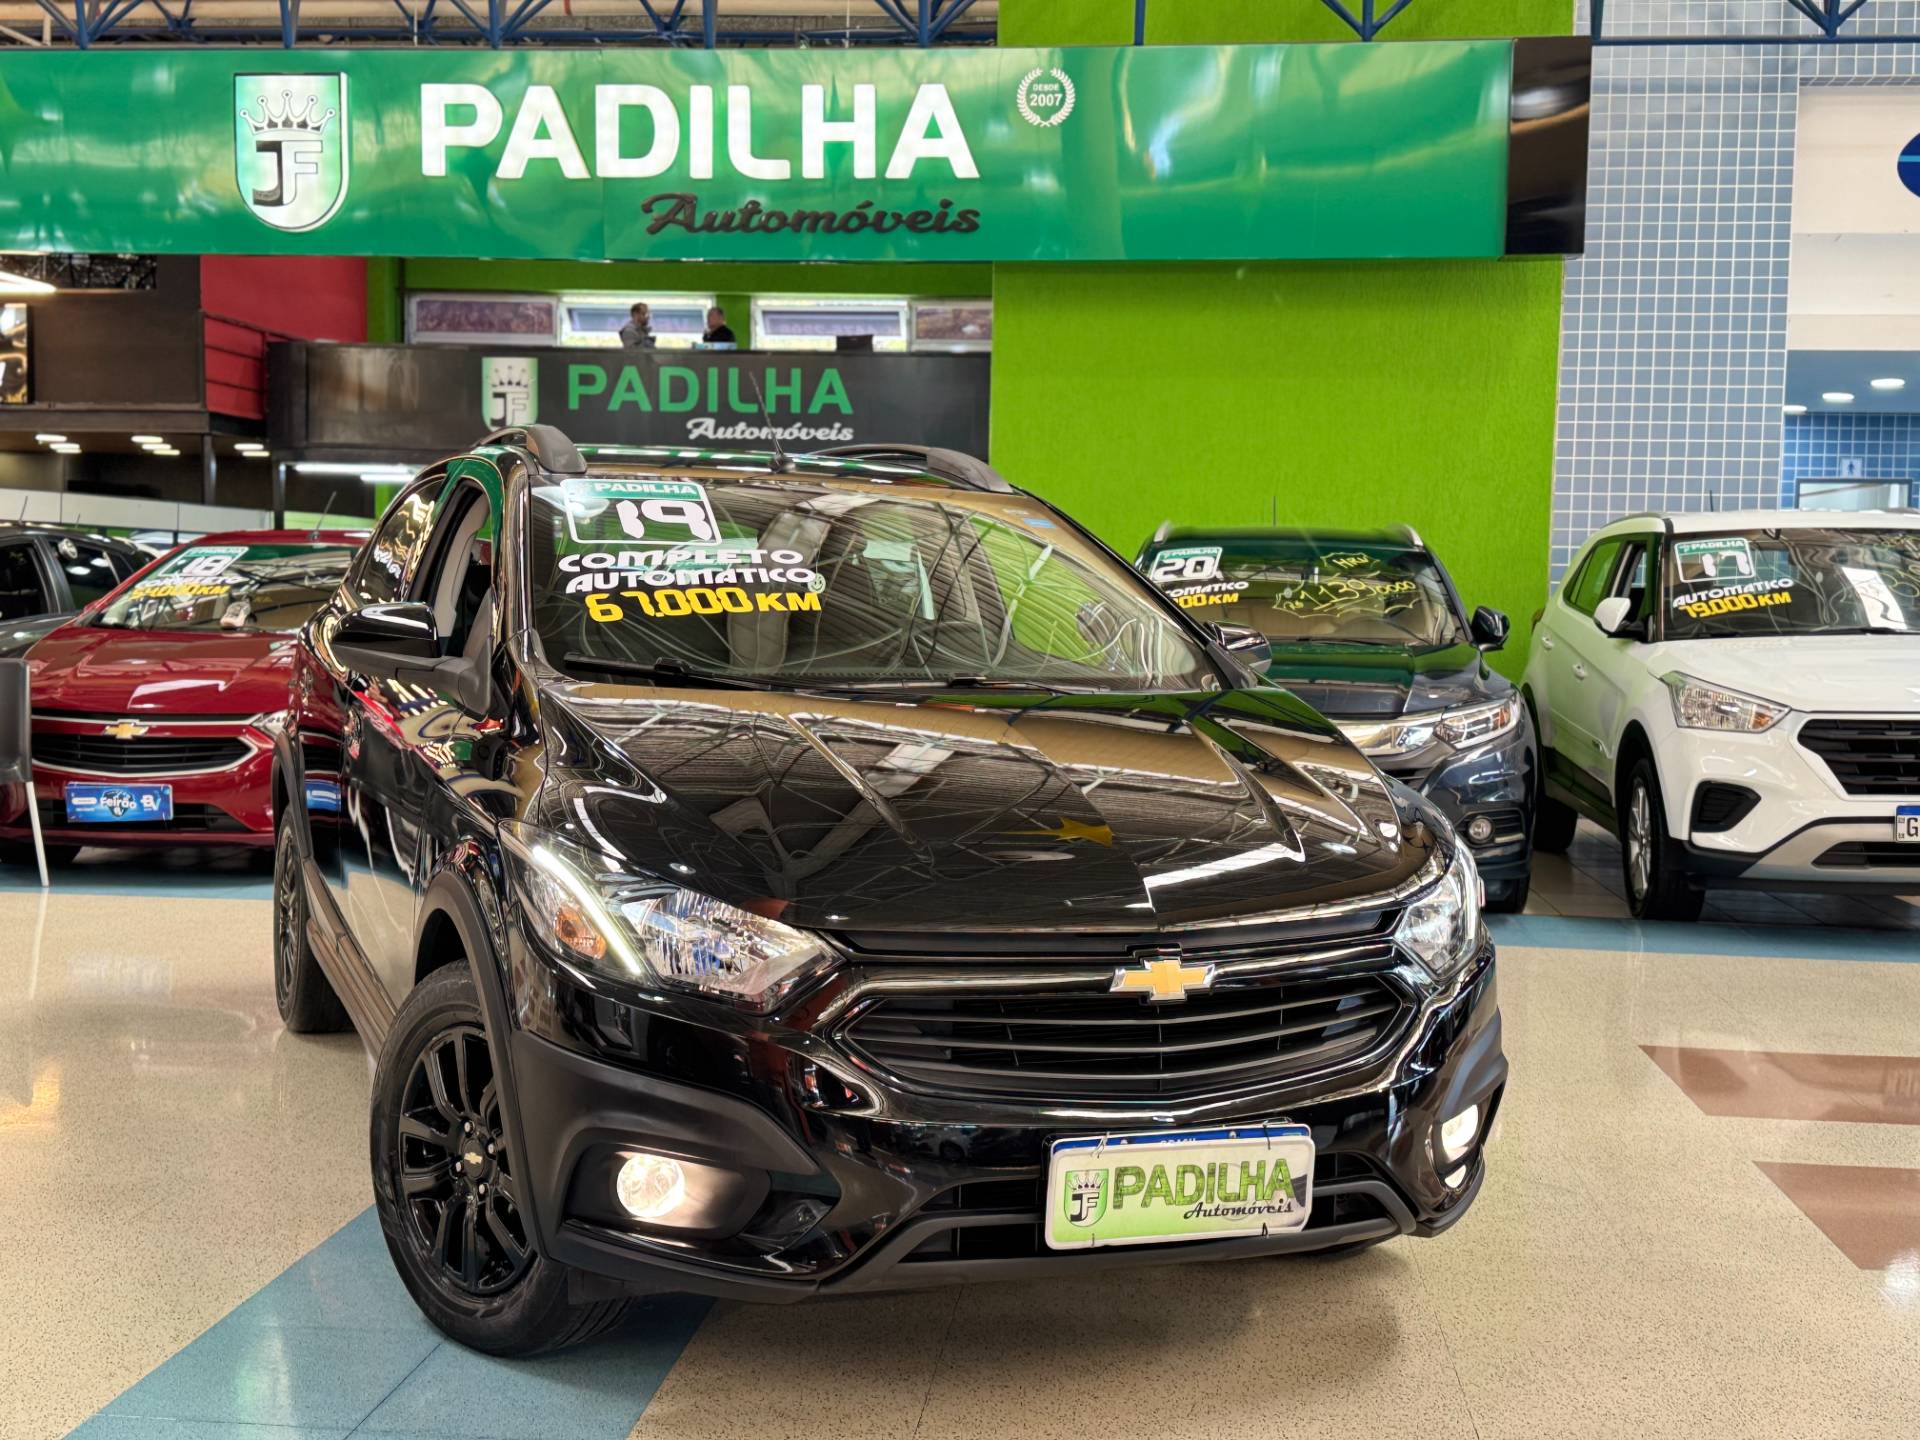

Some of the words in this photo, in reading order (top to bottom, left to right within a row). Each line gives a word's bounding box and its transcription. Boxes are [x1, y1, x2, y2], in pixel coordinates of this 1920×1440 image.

[1032, 83, 1060, 92] DESDE
[1030, 93, 1063, 107] 2007
[420, 83, 981, 180] PADILHA
[252, 139, 323, 208] JF
[641, 192, 981, 235] Automóveis
[568, 364, 854, 415] PADILHA
[686, 417, 854, 442] Automóveis
[594, 482, 697, 495] PADILHA
[616, 500, 713, 541] 19
[1691, 540, 1745, 550] PADILHA
[558, 550, 804, 572] COMPLETO
[1153, 556, 1216, 580] 20
[1702, 551, 1751, 577] 17
[755, 591, 822, 611] KM
[1208, 593, 1239, 605] KM
[1758, 591, 1792, 607] KM
[1112, 1158, 1295, 1210] PADILHA
[1070, 1191, 1100, 1222] JF
[1183, 1198, 1294, 1220] Automóveis
